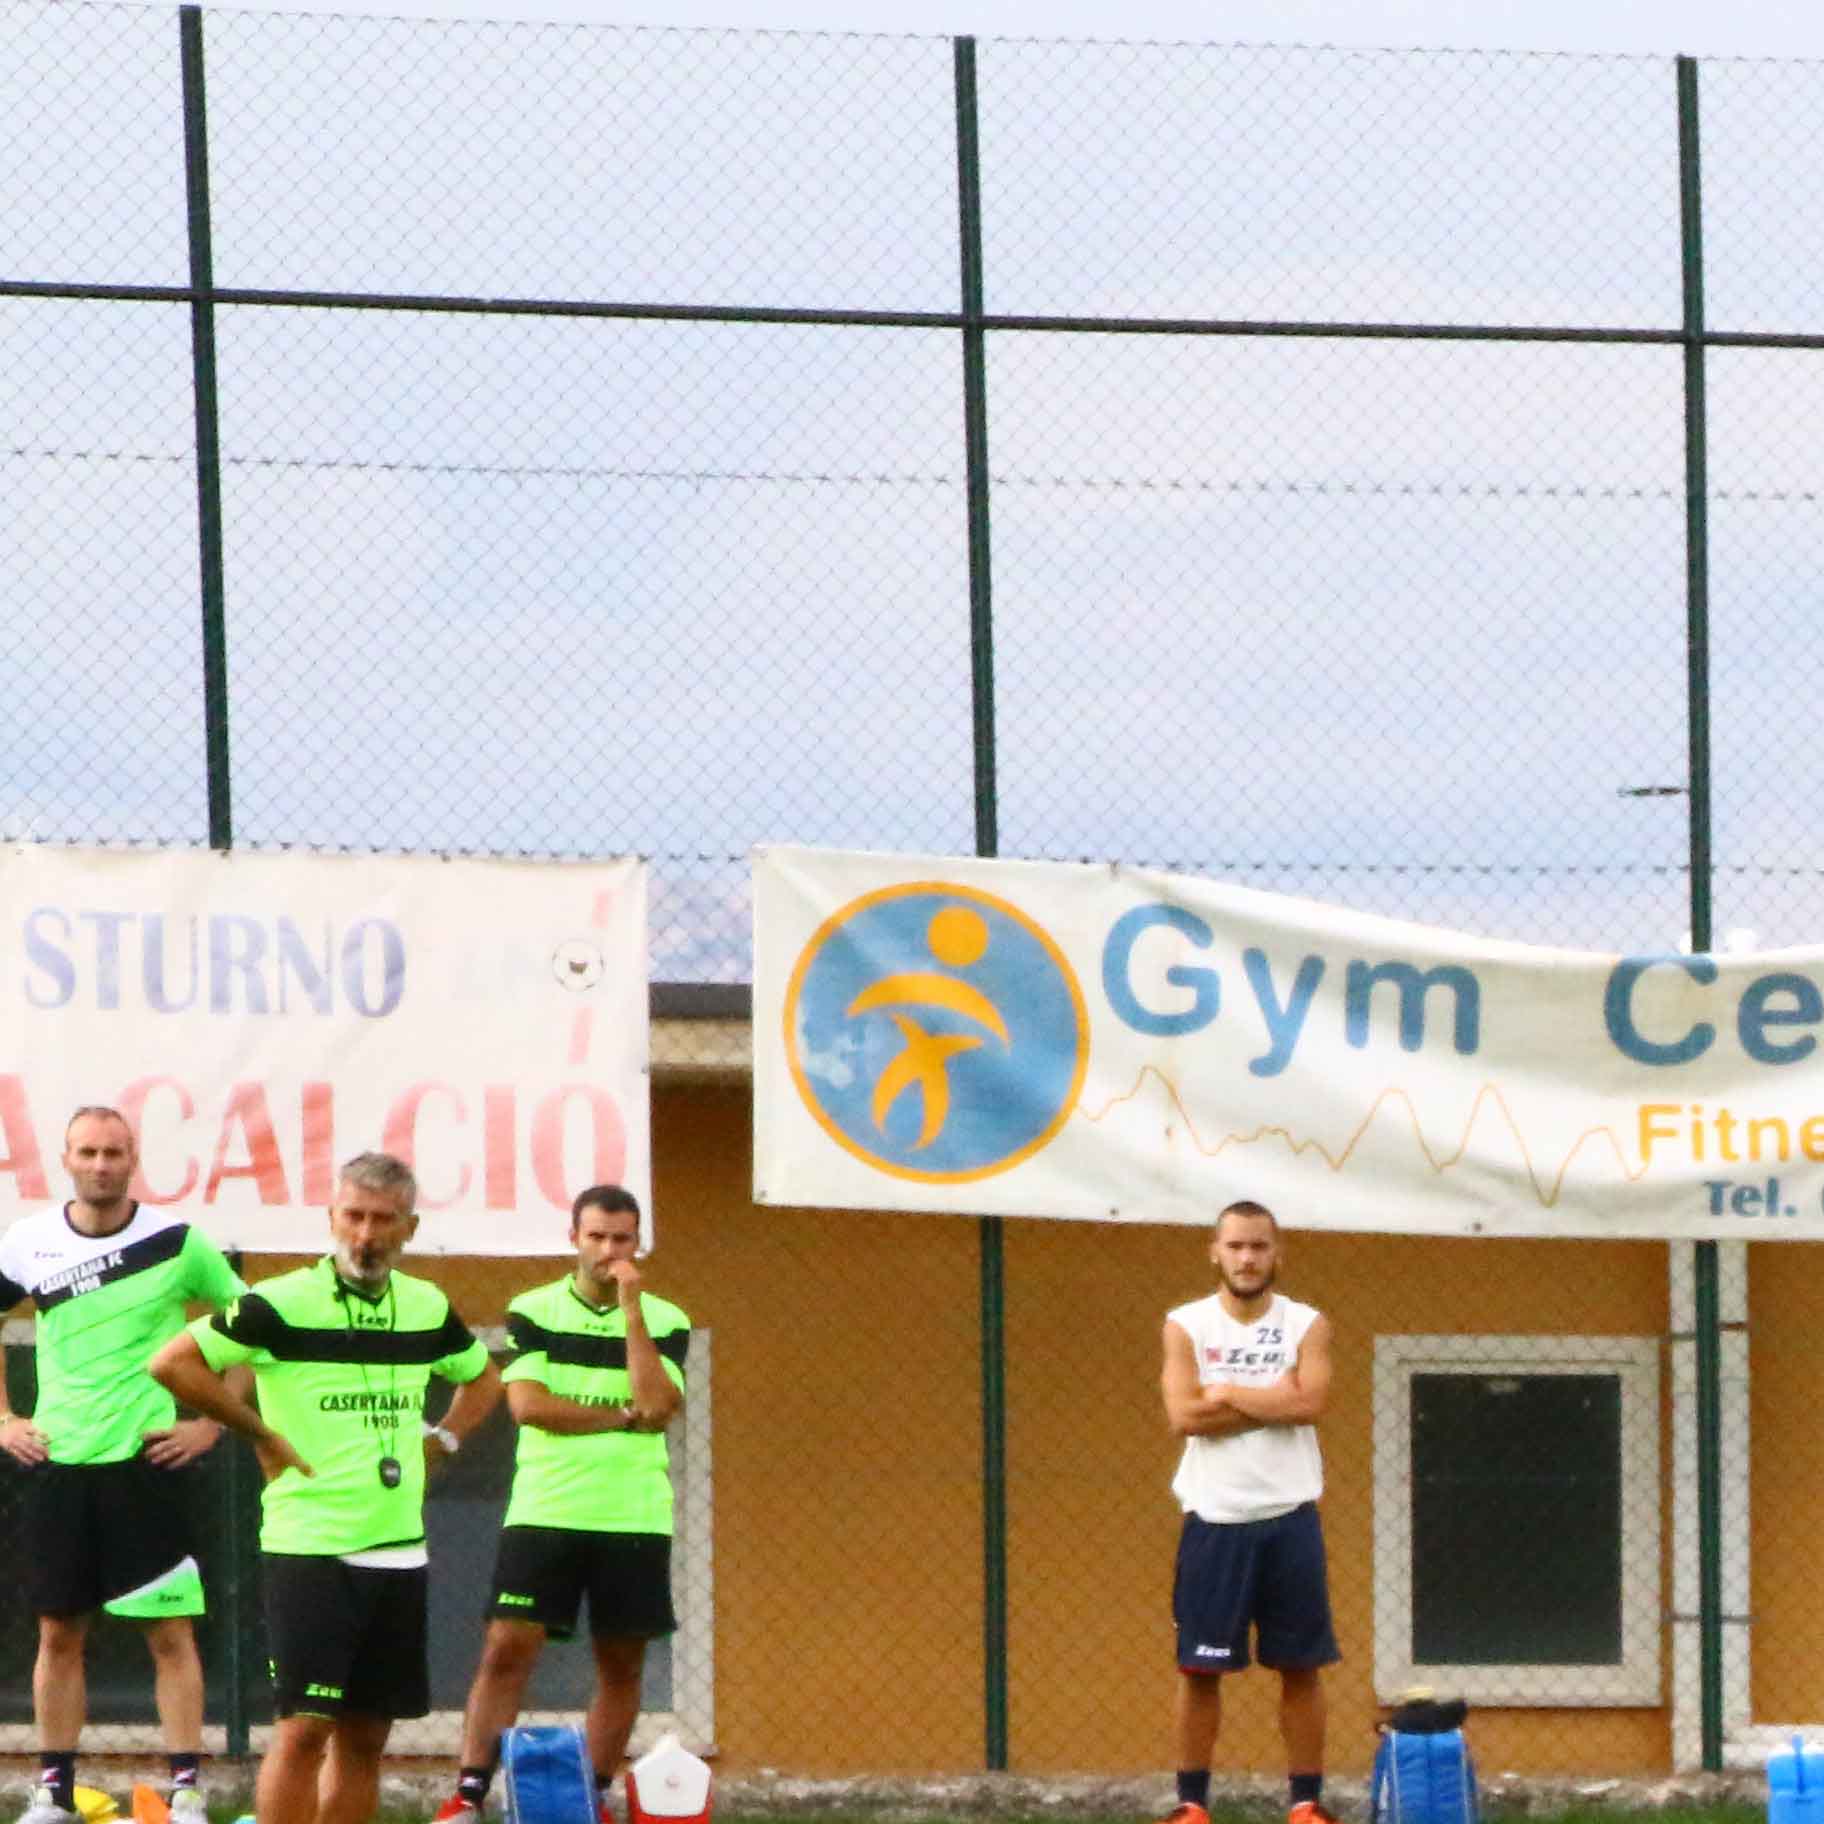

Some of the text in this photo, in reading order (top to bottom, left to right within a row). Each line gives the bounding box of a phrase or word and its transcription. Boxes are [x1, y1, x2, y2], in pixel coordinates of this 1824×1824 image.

[22, 906, 407, 1020] STURNO
[1101, 902, 1482, 1078] Gym
[115, 1074, 627, 1212] CALCIO
[1701, 1177, 1798, 1219] Tel.
[319, 1393, 410, 1412] CASERTANA
